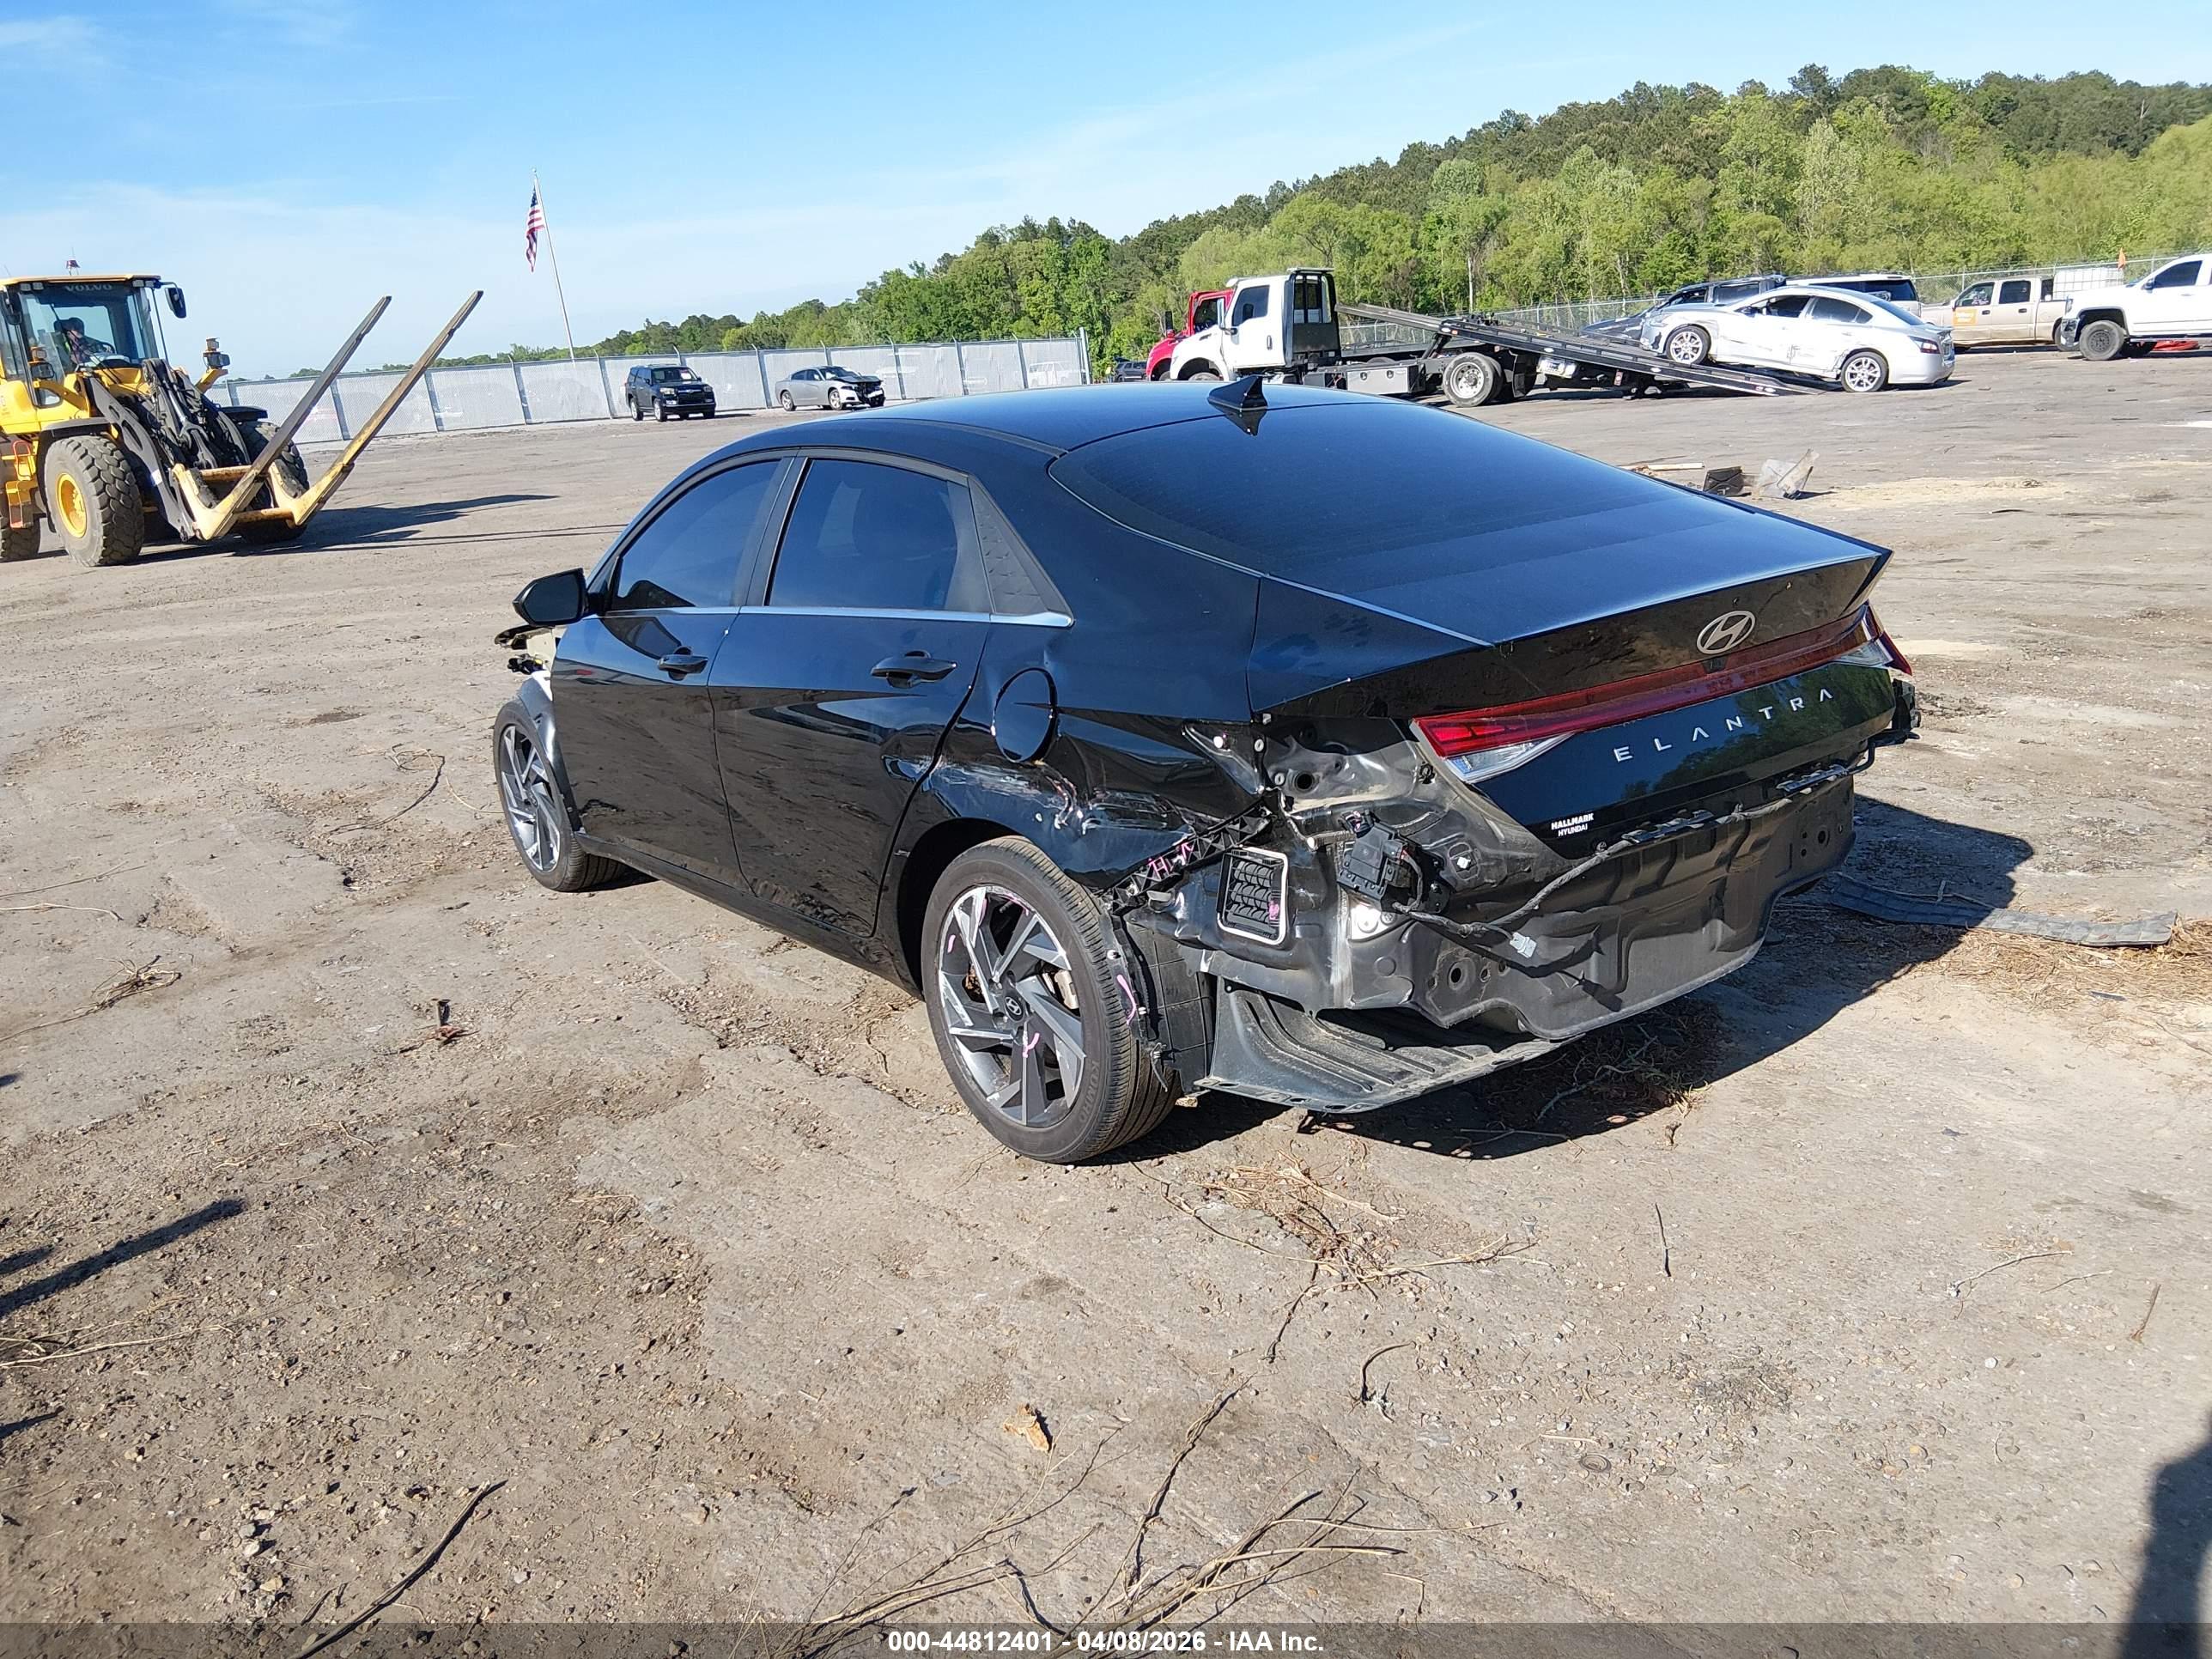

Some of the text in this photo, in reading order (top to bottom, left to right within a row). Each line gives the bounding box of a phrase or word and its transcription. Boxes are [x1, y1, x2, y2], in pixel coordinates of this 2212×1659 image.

[1613, 688, 1833, 763] ELANTRA
[1551, 813, 1595, 830] HALLMARK
[1558, 823, 1589, 837] HYUNDAI
